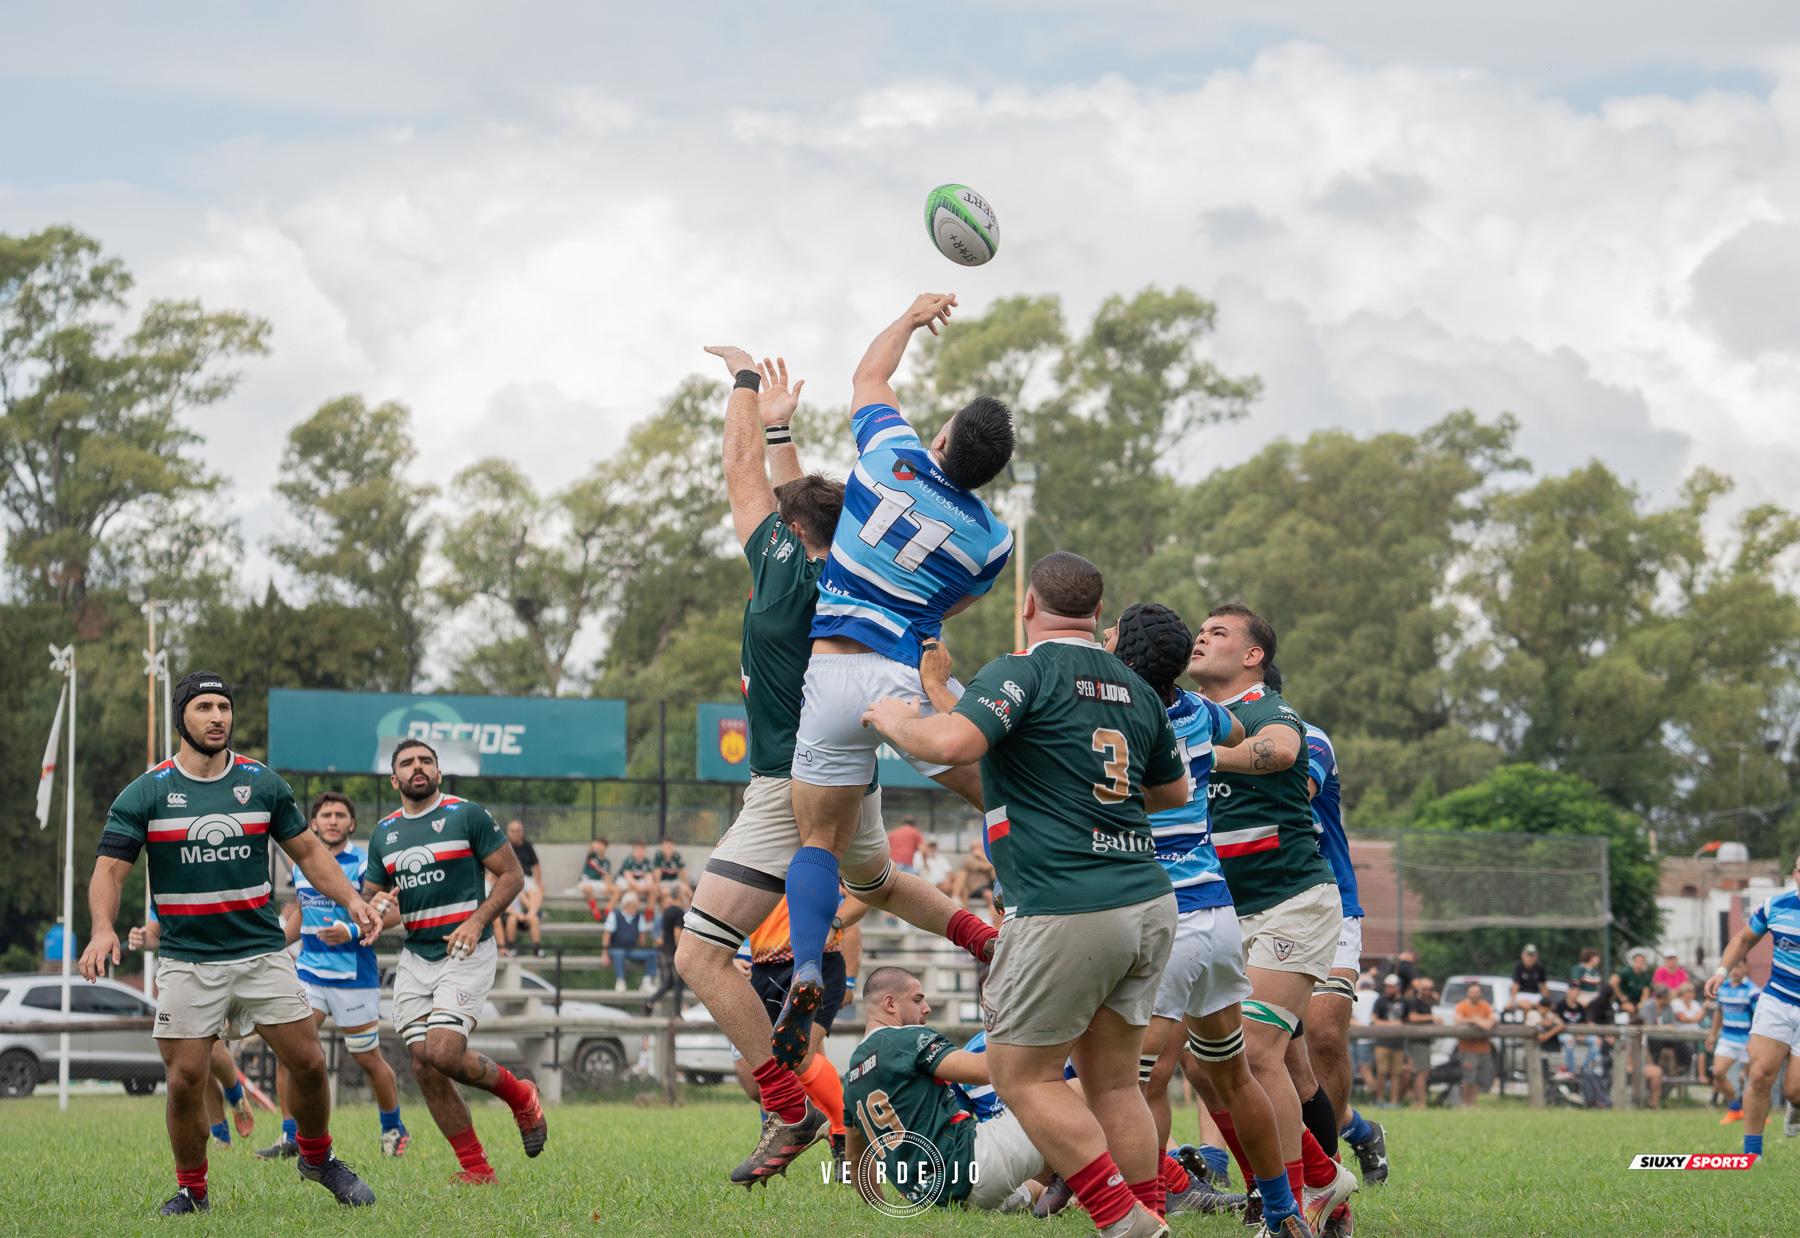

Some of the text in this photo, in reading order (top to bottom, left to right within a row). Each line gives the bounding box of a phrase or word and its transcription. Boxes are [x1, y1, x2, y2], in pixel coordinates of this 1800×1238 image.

[914, 480, 977, 527] AUTOSANZ
[858, 481, 956, 573] 11
[977, 696, 1012, 732] MAGMA
[241, 763, 260, 773] YPF
[1092, 727, 1132, 804] 3
[180, 845, 252, 864] Macro
[395, 868, 446, 891] Macro
[856, 1089, 906, 1160] 19
